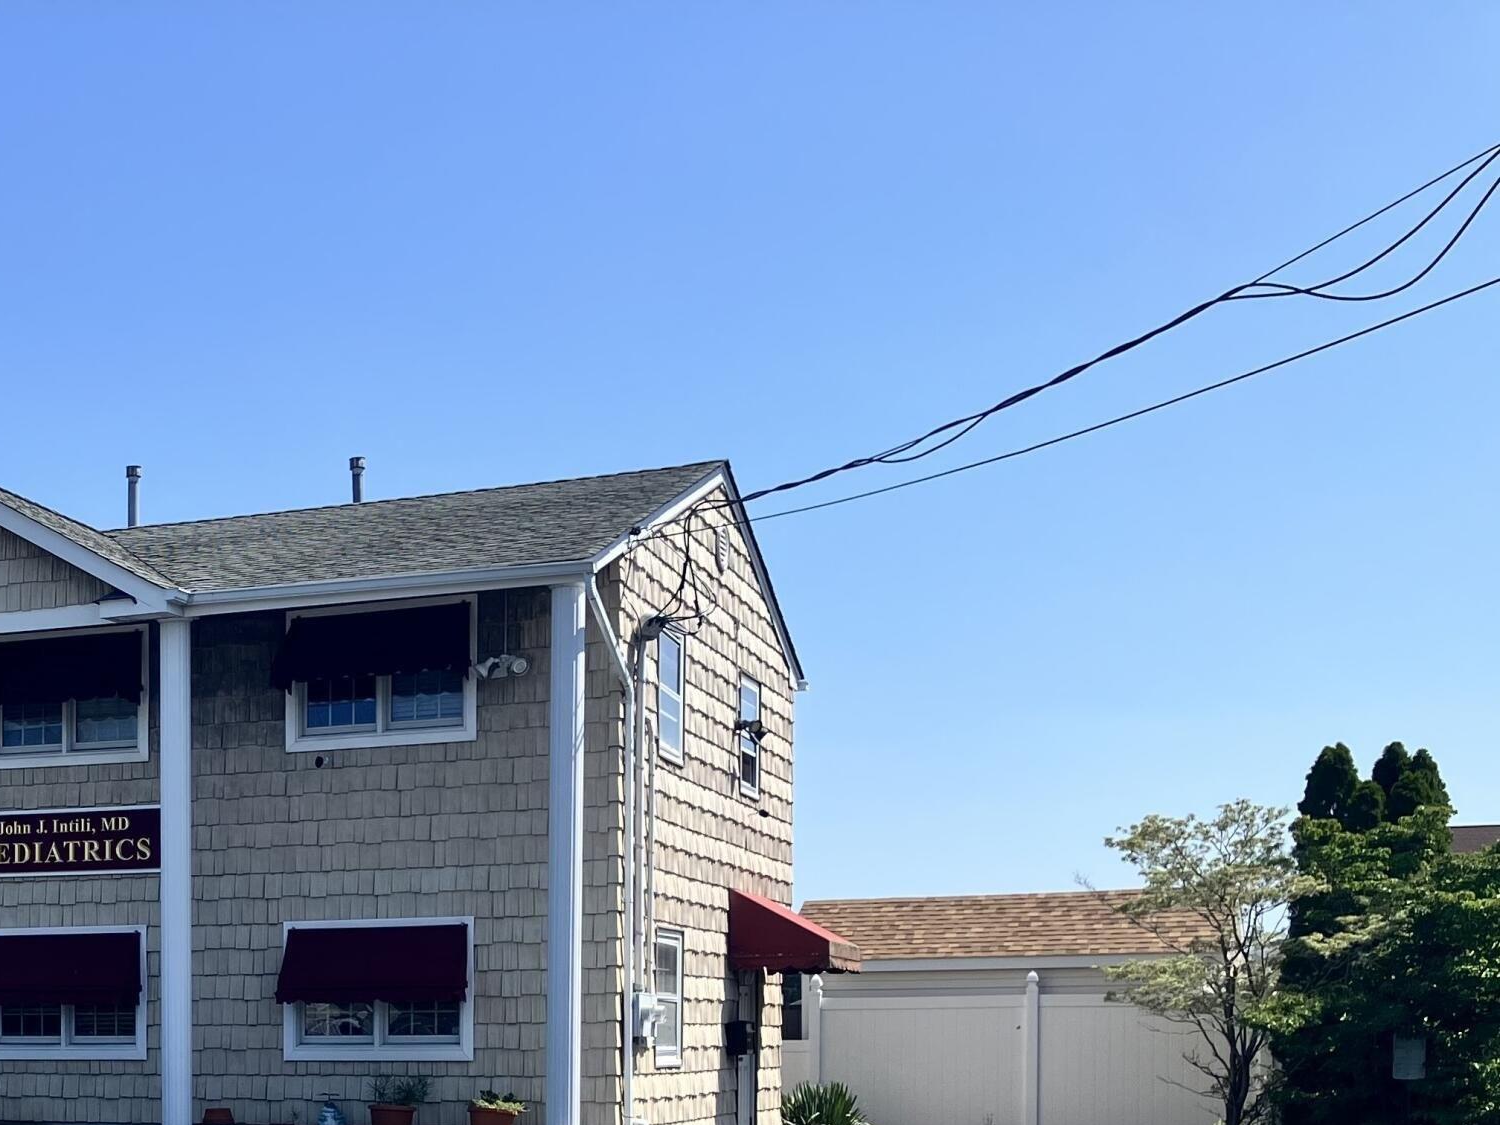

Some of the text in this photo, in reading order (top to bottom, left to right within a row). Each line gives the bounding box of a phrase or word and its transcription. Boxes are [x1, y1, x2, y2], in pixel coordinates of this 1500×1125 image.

[36, 819, 48, 834] J.
[53, 817, 96, 835] Intili,
[101, 816, 130, 832] MD
